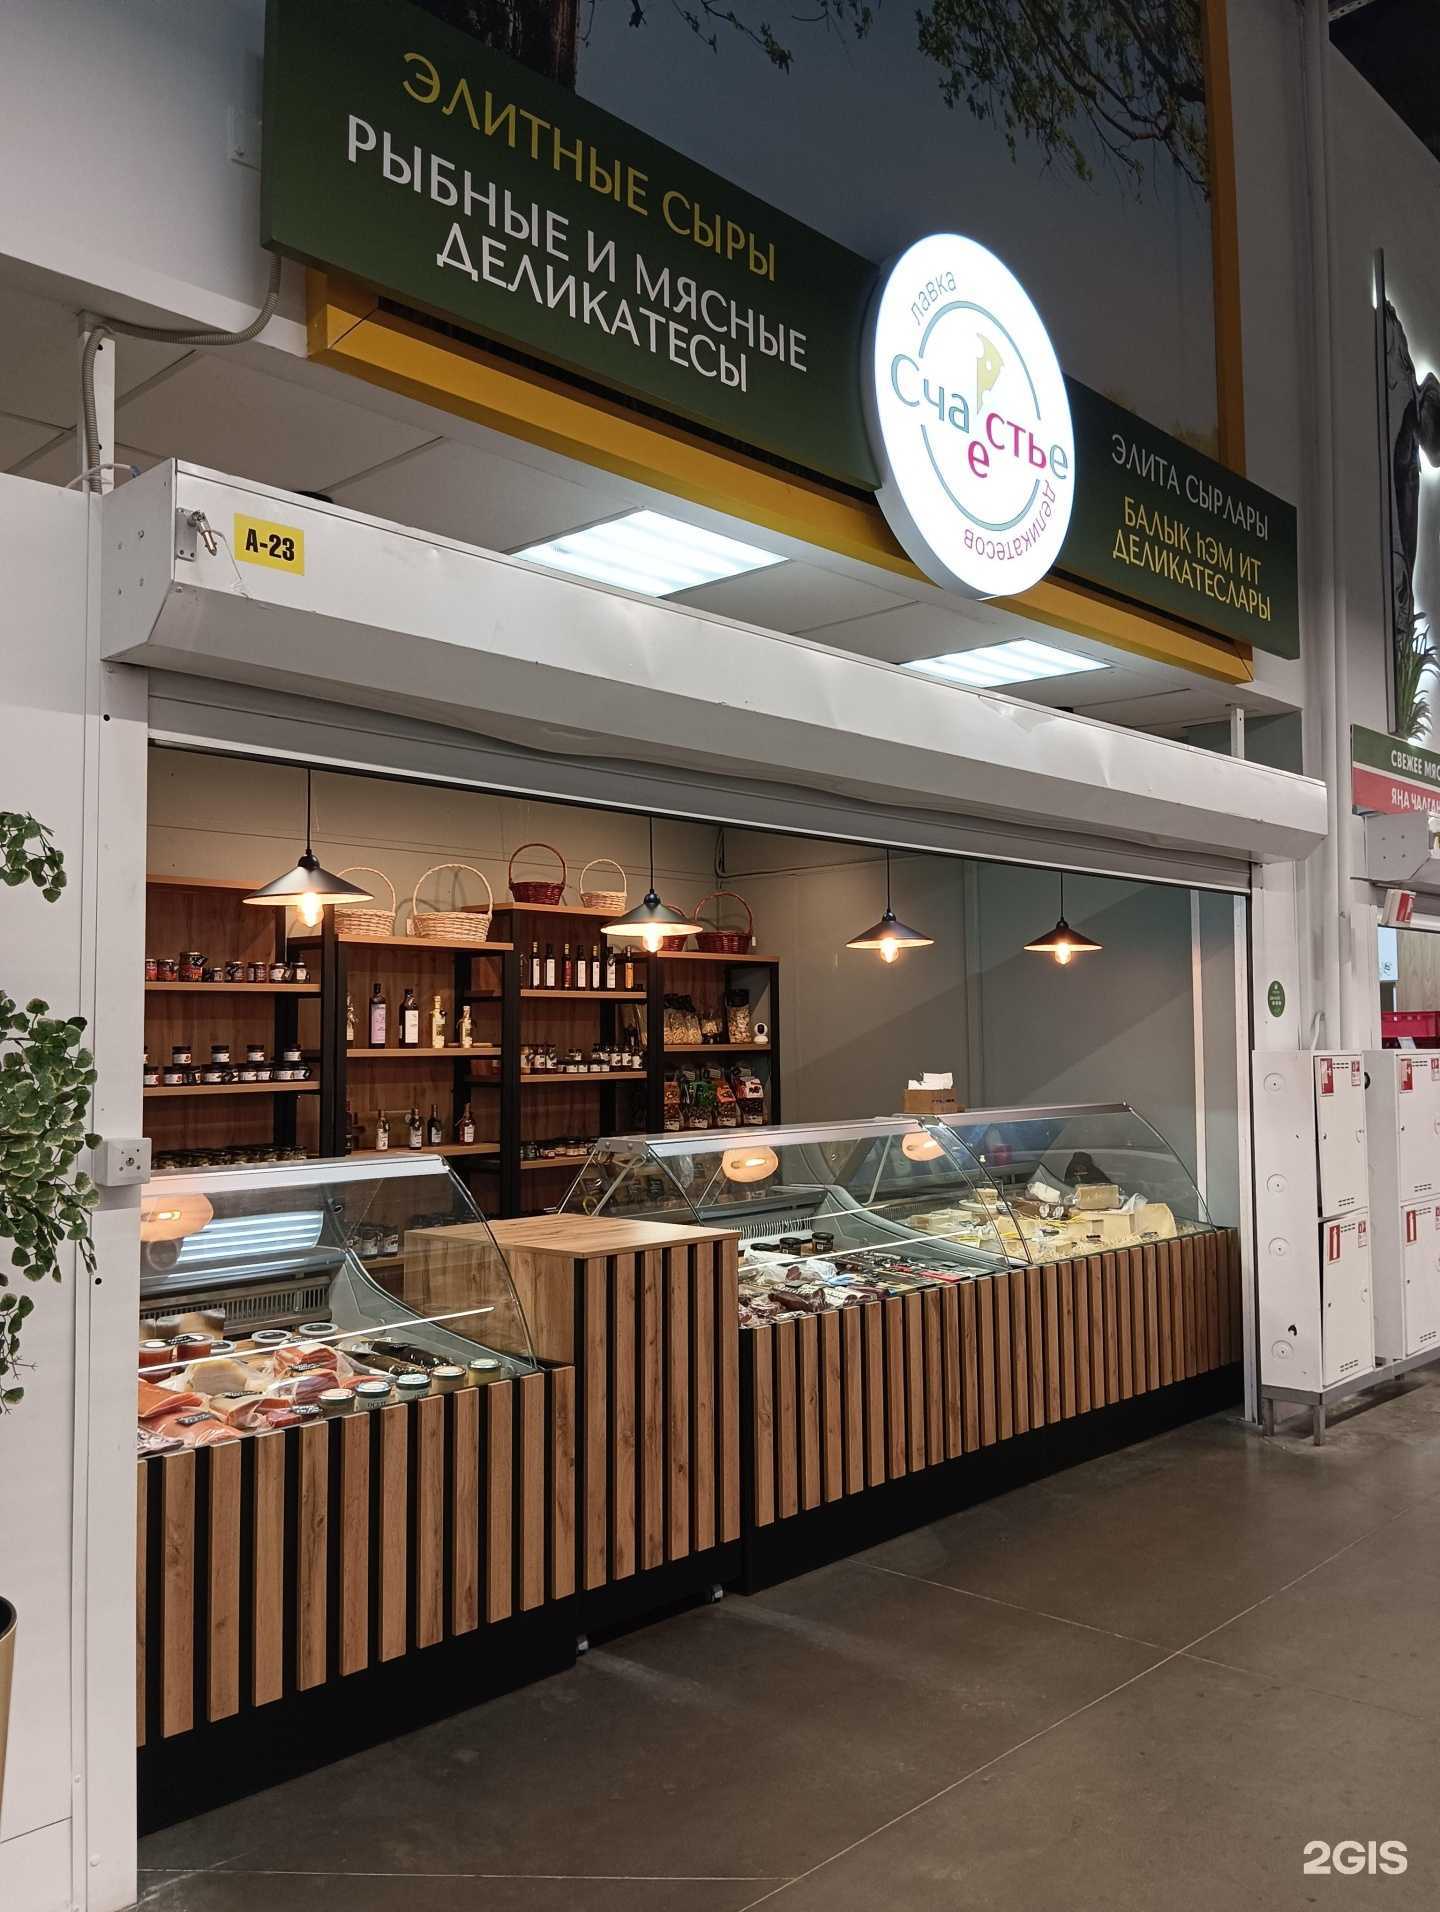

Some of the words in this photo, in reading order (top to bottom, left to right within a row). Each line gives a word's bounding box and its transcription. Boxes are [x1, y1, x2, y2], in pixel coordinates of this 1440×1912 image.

[403, 52, 649, 217] ЭЛИТНЫЕ
[662, 189, 776, 282] СЫРЫ
[347, 113, 570, 262] РЫБНЫЕ
[587, 229, 616, 283] И
[635, 253, 808, 374] МЯСНЫЕ
[436, 222, 747, 393] ДЕЛИКАТЕСЫ
[910, 271, 958, 326] лавка
[963, 479, 1057, 561] деликатесов
[1111, 433, 1181, 496] ЭЛИТА
[1185, 474, 1269, 541] СЫРЛАРЫ
[1112, 528, 1272, 622] ДЕЛИКАТЕСЛАРЫ
[1123, 495, 1192, 554] БАЛЫК
[1239, 552, 1262, 585] ИТ
[1391, 749, 1423, 775] СВЕЖЕЕ
